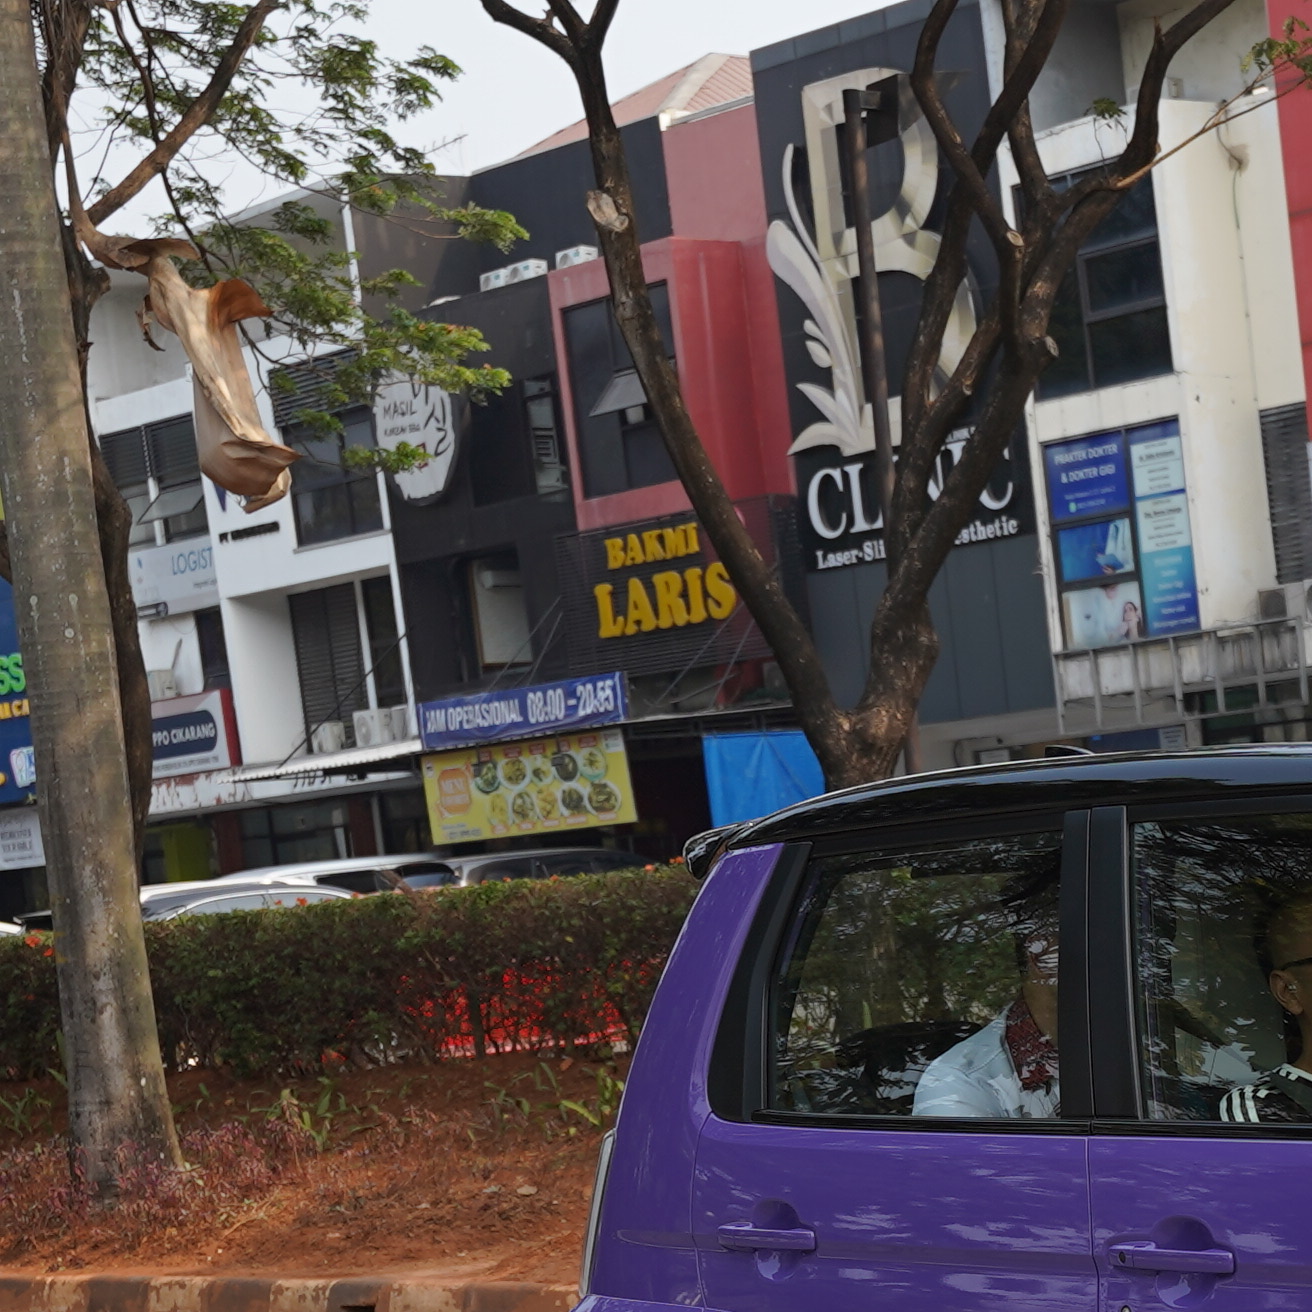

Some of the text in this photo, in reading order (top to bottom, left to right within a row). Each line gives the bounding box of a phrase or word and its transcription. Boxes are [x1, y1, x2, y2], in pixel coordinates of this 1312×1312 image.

[171, 546, 213, 576] LOGIST
[604, 522, 700, 570] BAKMI
[594, 561, 737, 639] LARIS
[447, 698, 524, 732] OPERASIONAL
[152, 721, 216, 747] PPO CIKARANG
